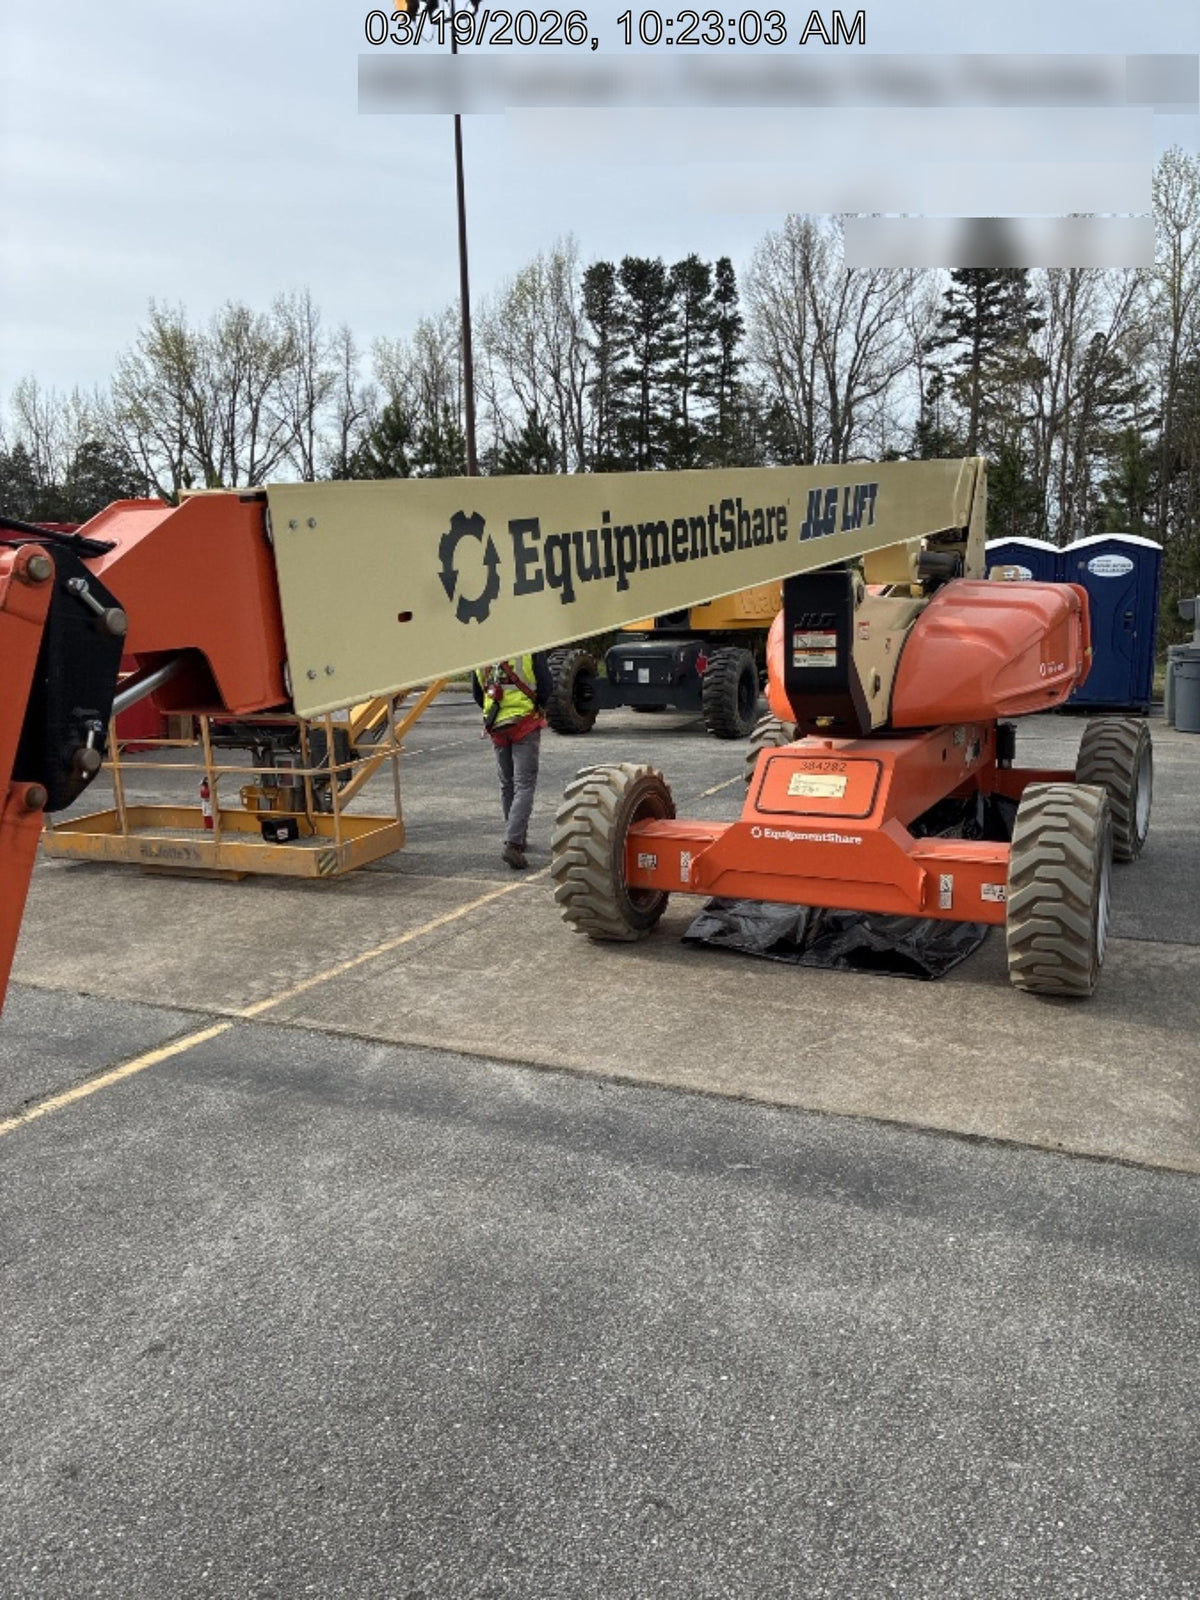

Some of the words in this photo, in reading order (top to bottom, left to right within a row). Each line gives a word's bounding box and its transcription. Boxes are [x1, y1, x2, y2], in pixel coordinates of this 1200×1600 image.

[799, 486, 839, 543] JLG
[840, 482, 879, 534] LIFT
[508, 497, 788, 605] EquipmentShare
[800, 760, 848, 773] 384282
[763, 827, 863, 845] EquipmentShare
